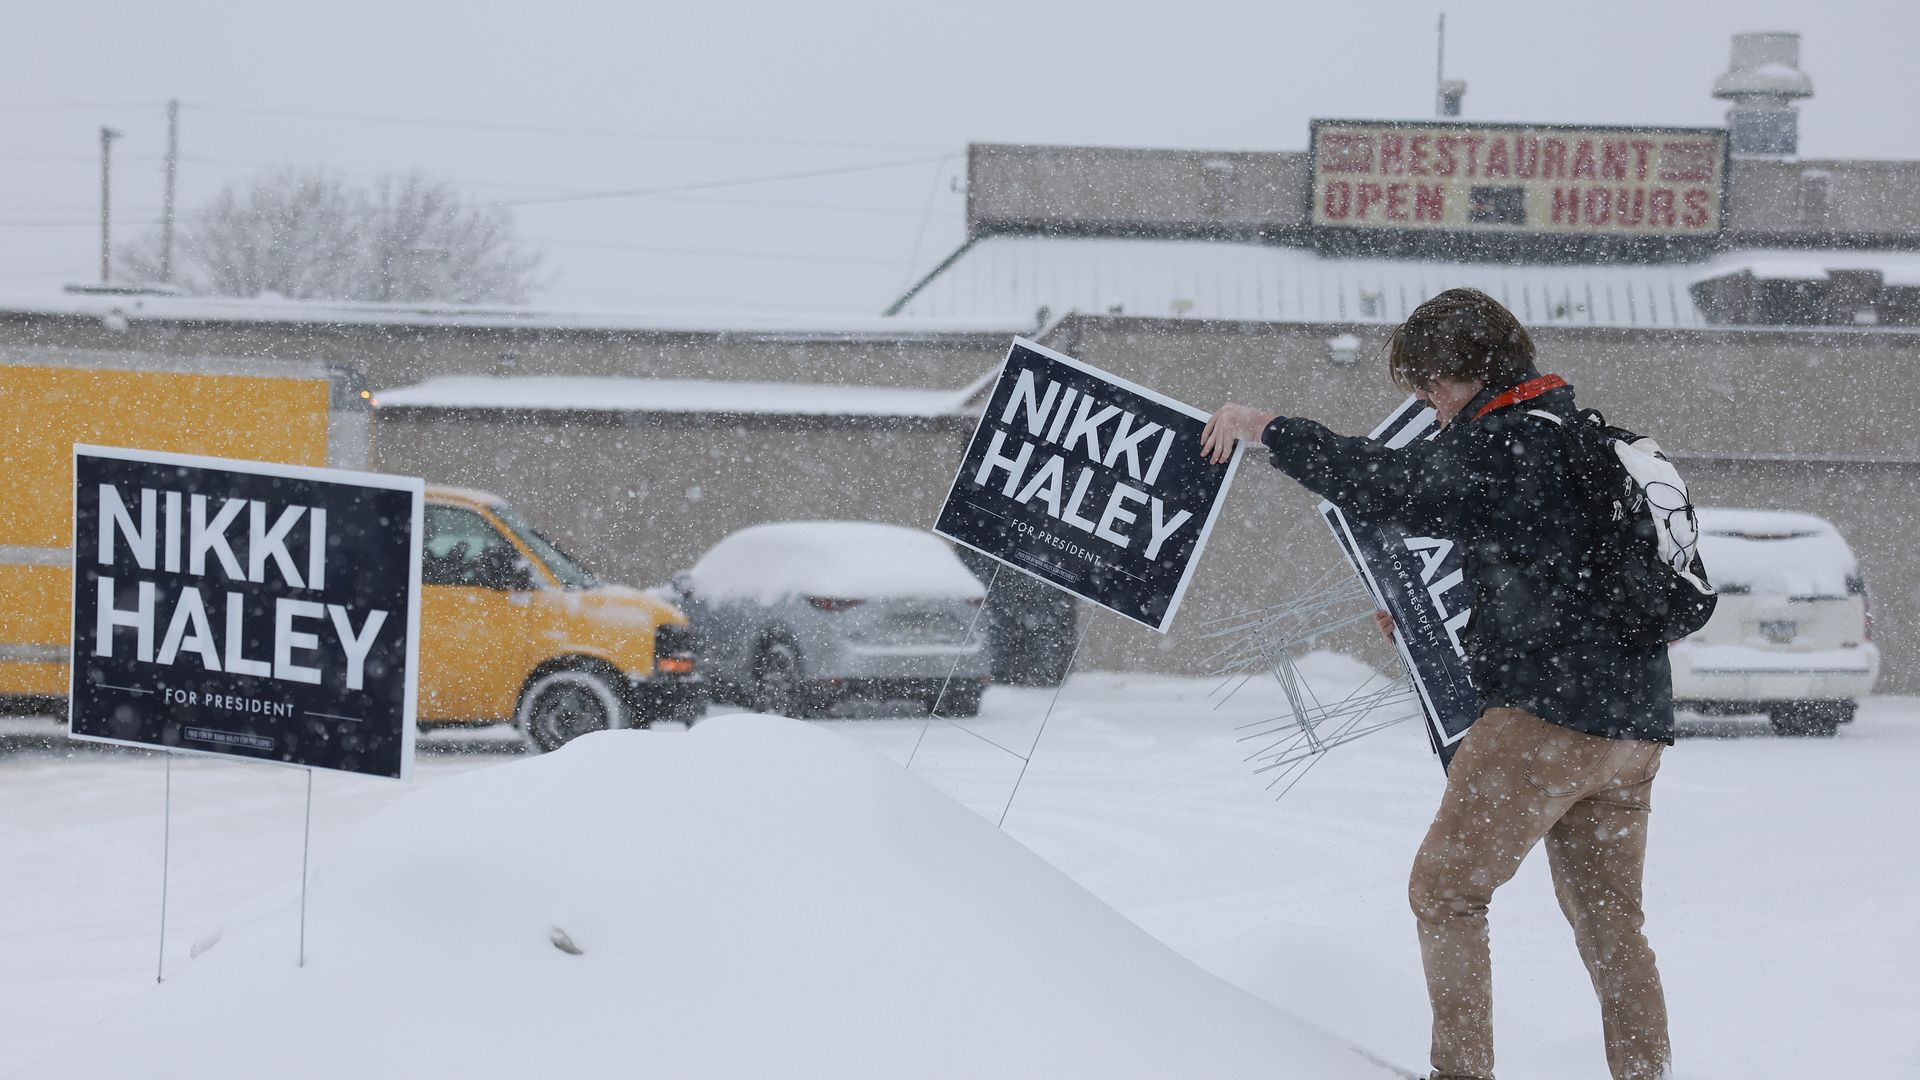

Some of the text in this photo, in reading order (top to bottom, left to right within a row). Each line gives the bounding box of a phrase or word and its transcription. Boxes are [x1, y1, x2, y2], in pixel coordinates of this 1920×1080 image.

[1324, 180, 1445, 223] OPEN
[1551, 186, 1711, 228] HOURS
[1379, 133, 1656, 181] RESTAURANT
[1000, 368, 1177, 486] NIKKI
[98, 483, 327, 591] NIKKI
[974, 429, 1193, 562] HALEY
[1011, 518, 1101, 565] FOR PRESIDENT
[96, 576, 389, 691] HALEY
[1390, 553, 1406, 579] FOR
[1403, 581, 1439, 647] PRESIDENT
[165, 688, 294, 718] FOR PRESIDENT
